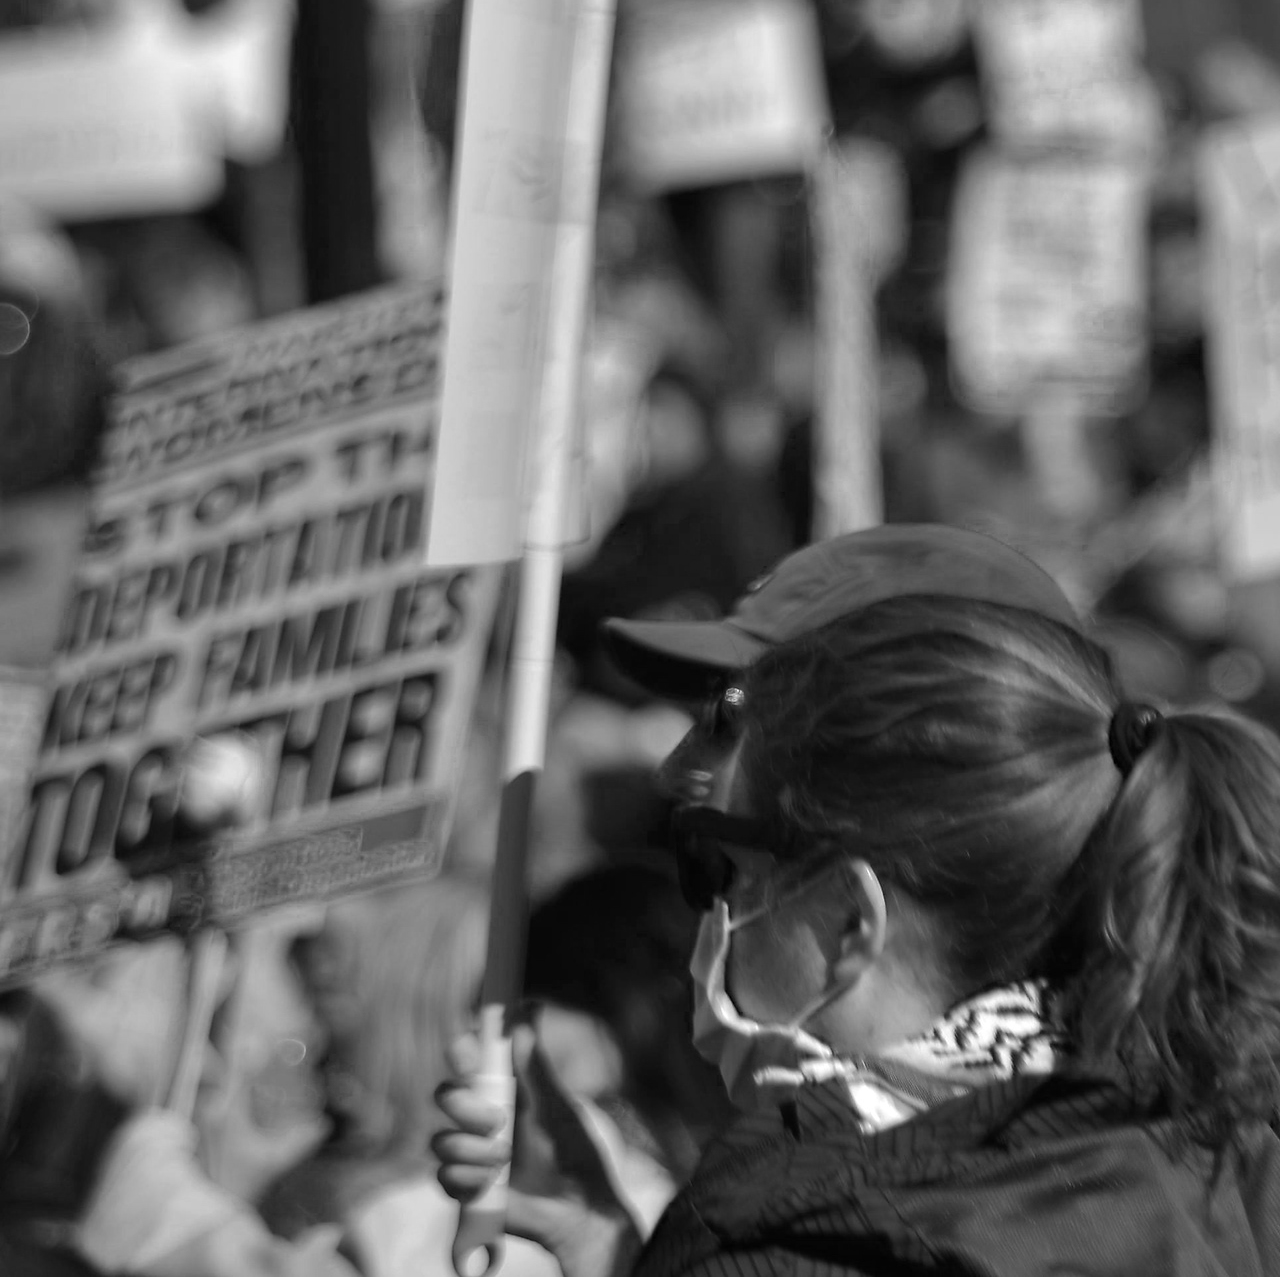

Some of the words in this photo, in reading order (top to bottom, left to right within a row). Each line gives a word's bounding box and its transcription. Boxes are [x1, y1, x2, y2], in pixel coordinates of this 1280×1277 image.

[84, 455, 305, 555] STOP
[40, 654, 175, 755] KEEP
[196, 569, 471, 709] FAMILIES
